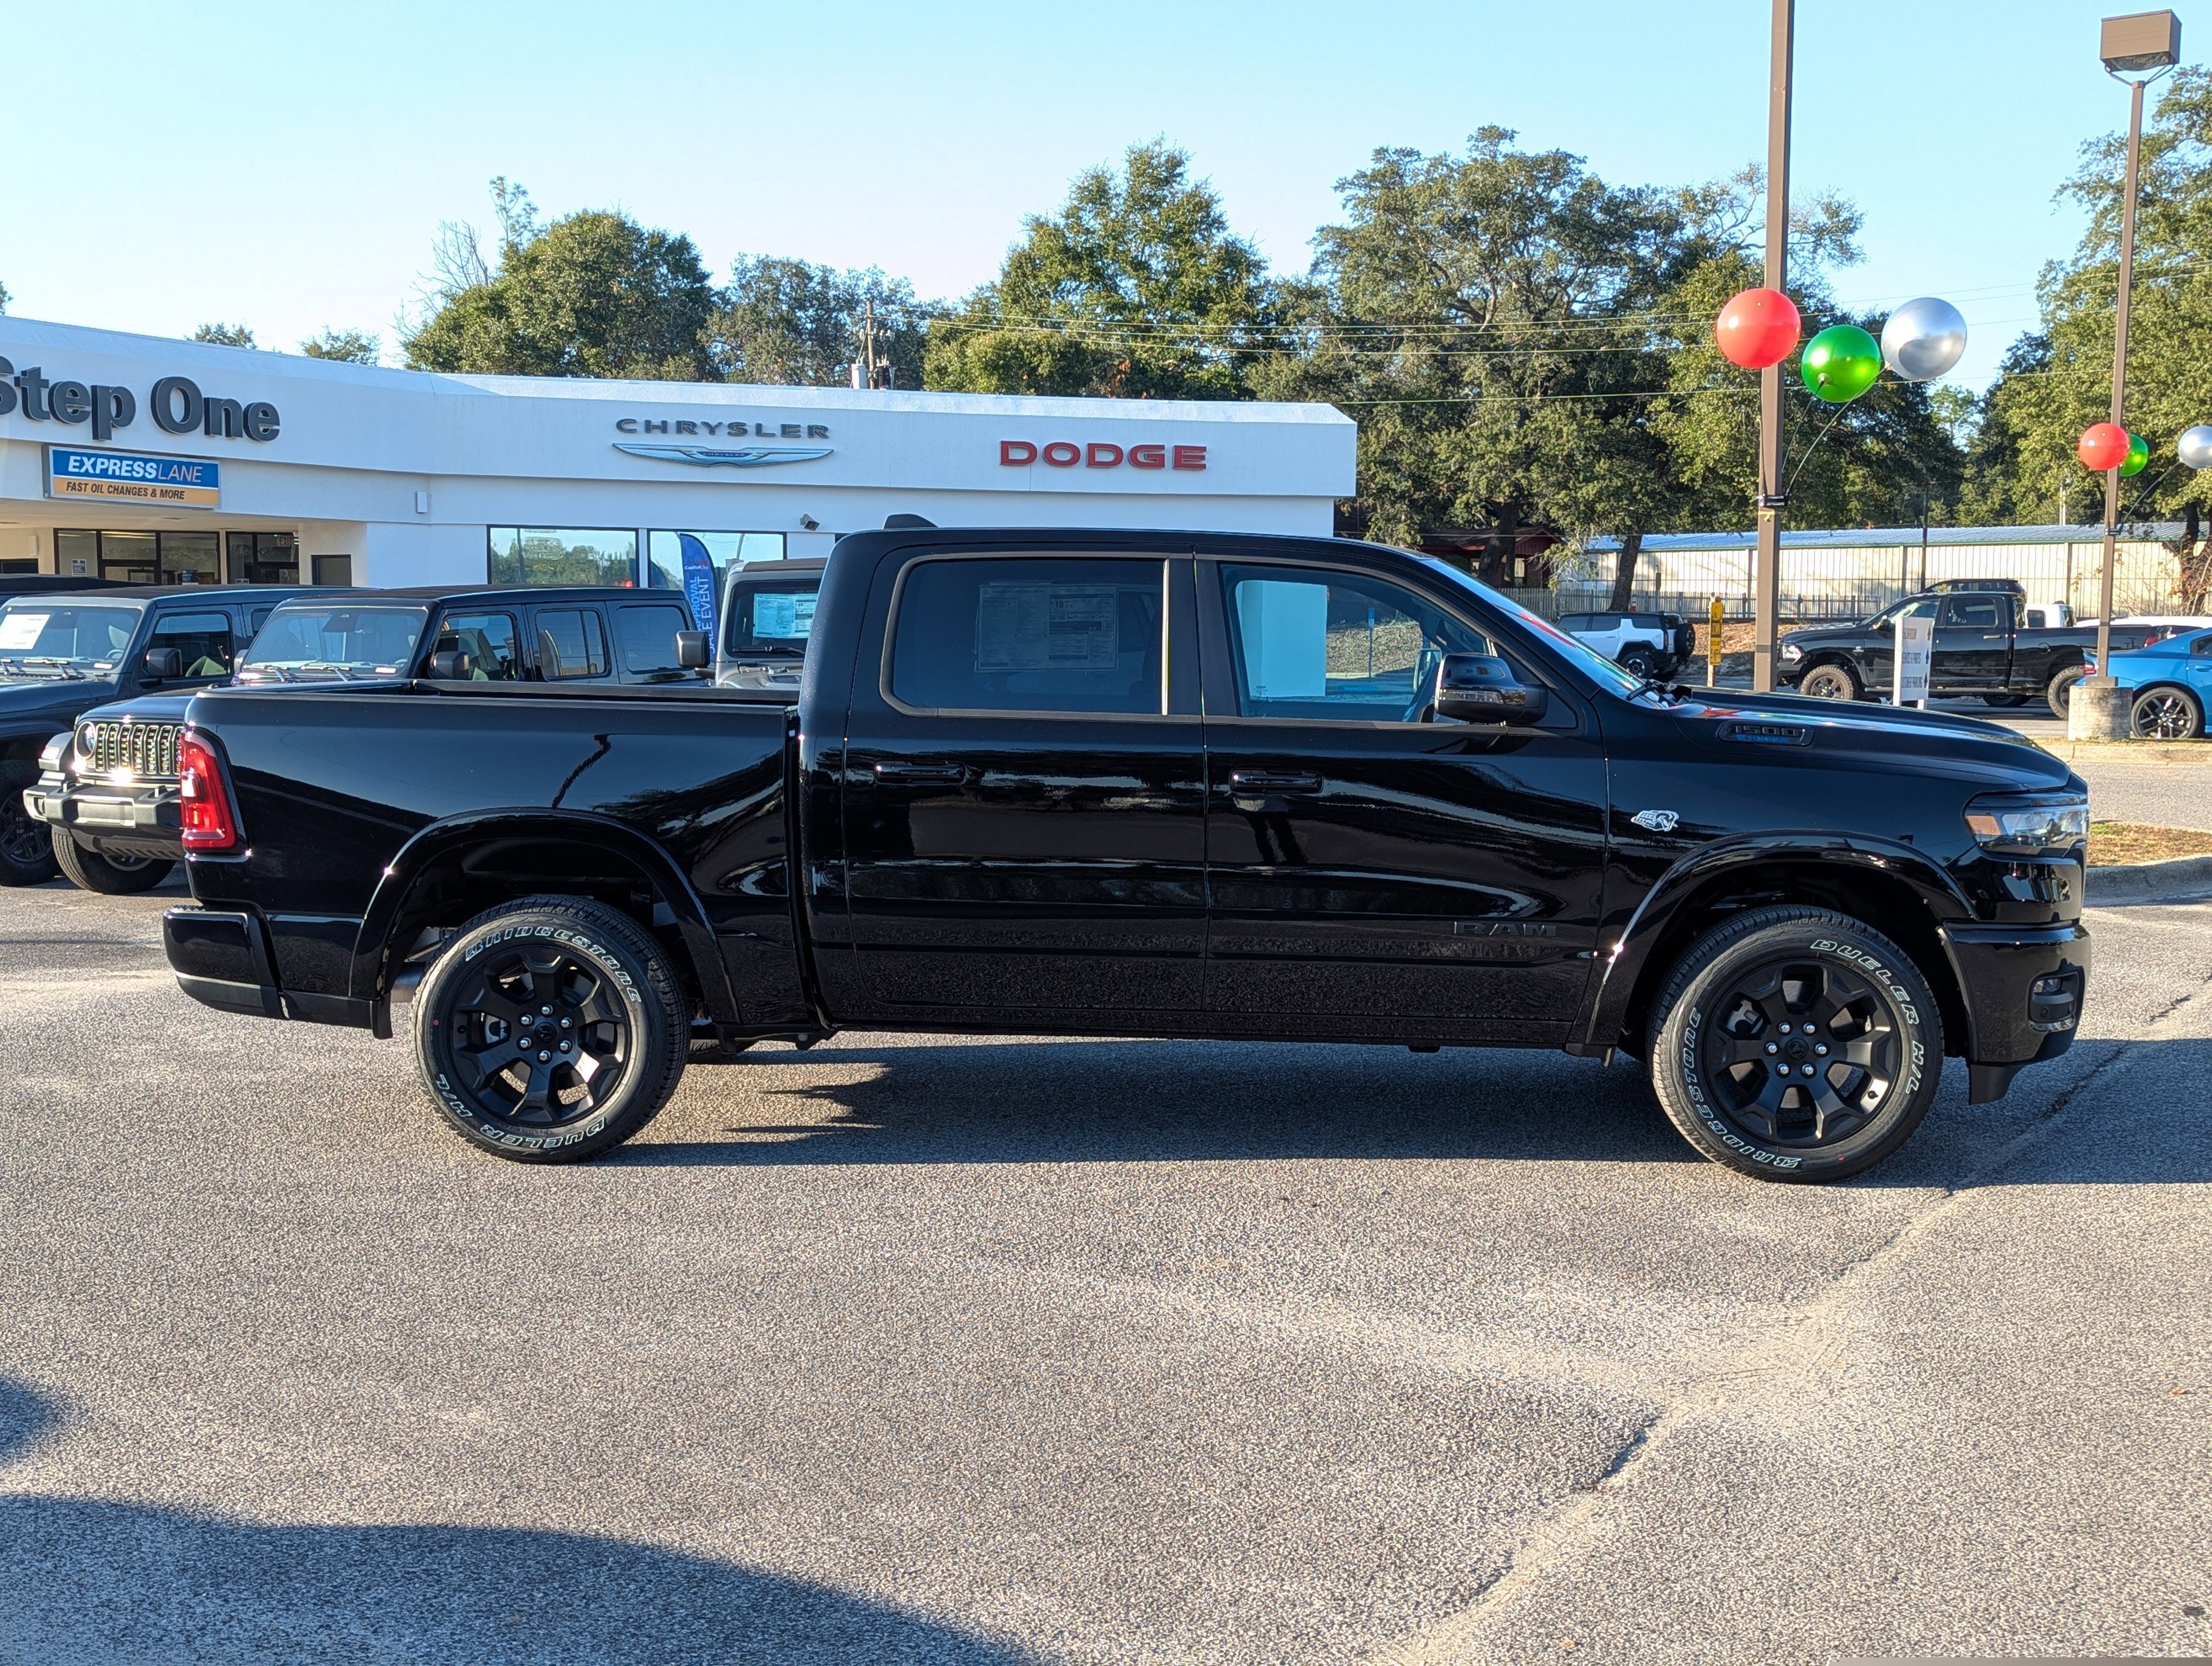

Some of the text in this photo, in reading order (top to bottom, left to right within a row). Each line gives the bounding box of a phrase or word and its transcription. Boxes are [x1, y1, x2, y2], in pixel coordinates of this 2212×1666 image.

[151, 376, 280, 441] One
[616, 418, 829, 438] CHRYSLER
[999, 440, 1207, 470] DODGE
[66, 481, 185, 500] FAST OIL CHANGES & MORE
[697, 576, 711, 619] EVENT
[1735, 725, 1799, 736] 1500
[1454, 921, 1557, 937] RAM
[465, 926, 642, 1003] BRIDGESTONE
[1810, 939, 1920, 1026] DUELER
[1682, 1007, 1803, 1169] BRIDGESTONE
[479, 1116, 608, 1149] DUELER
